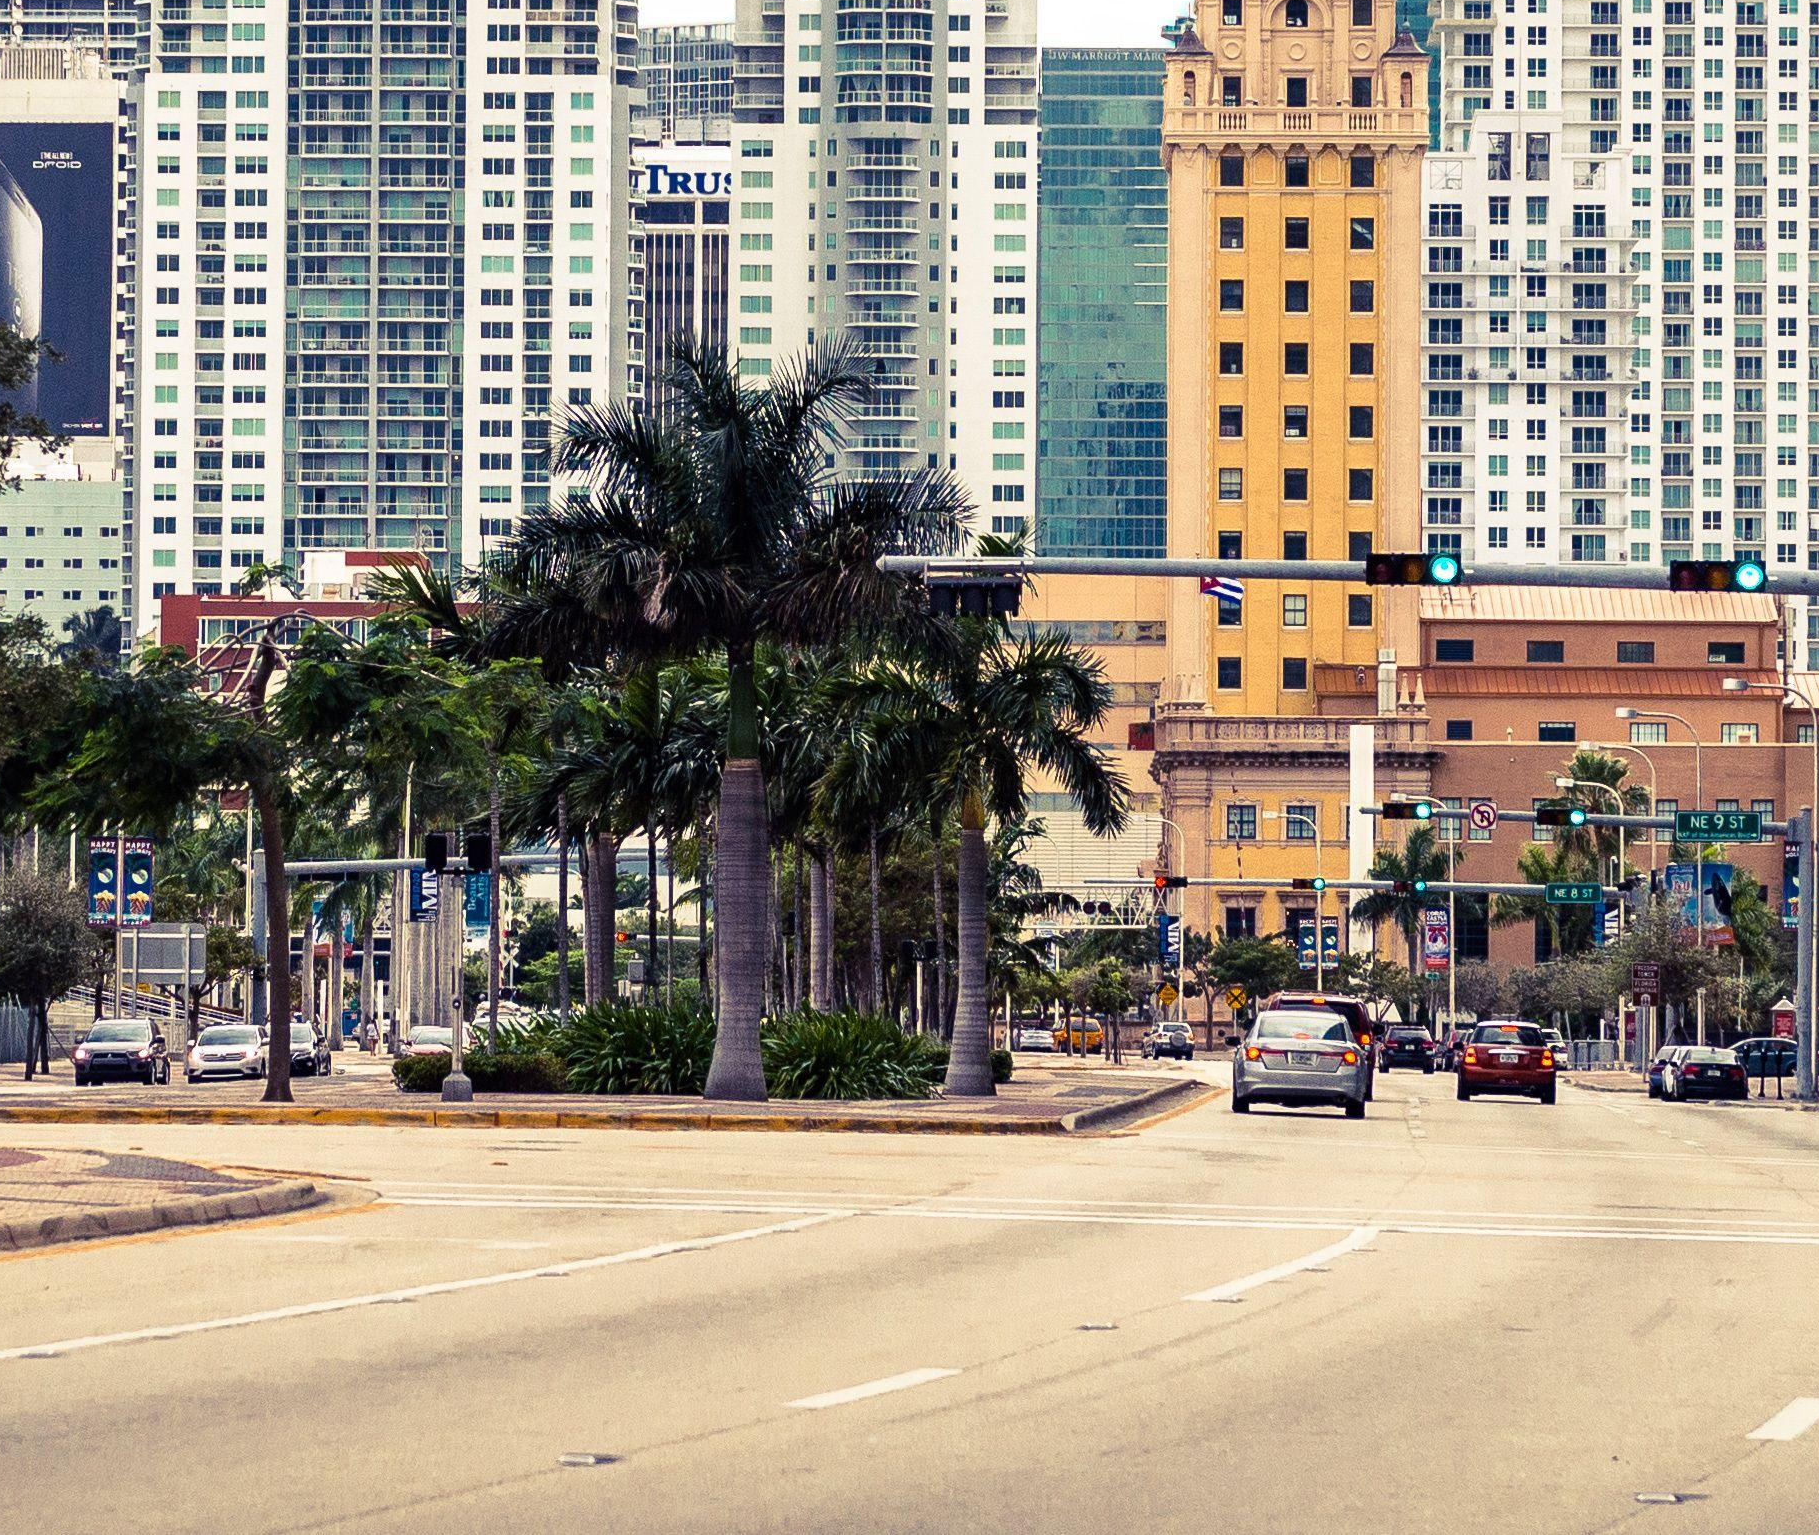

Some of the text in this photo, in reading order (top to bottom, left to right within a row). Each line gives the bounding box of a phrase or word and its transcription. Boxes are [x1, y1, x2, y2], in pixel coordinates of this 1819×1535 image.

[1071, 51, 1130, 61] MARRIOTT
[1690, 814, 1746, 829] NE 9 ST
[1554, 887, 1593, 899] NE 8 ST
